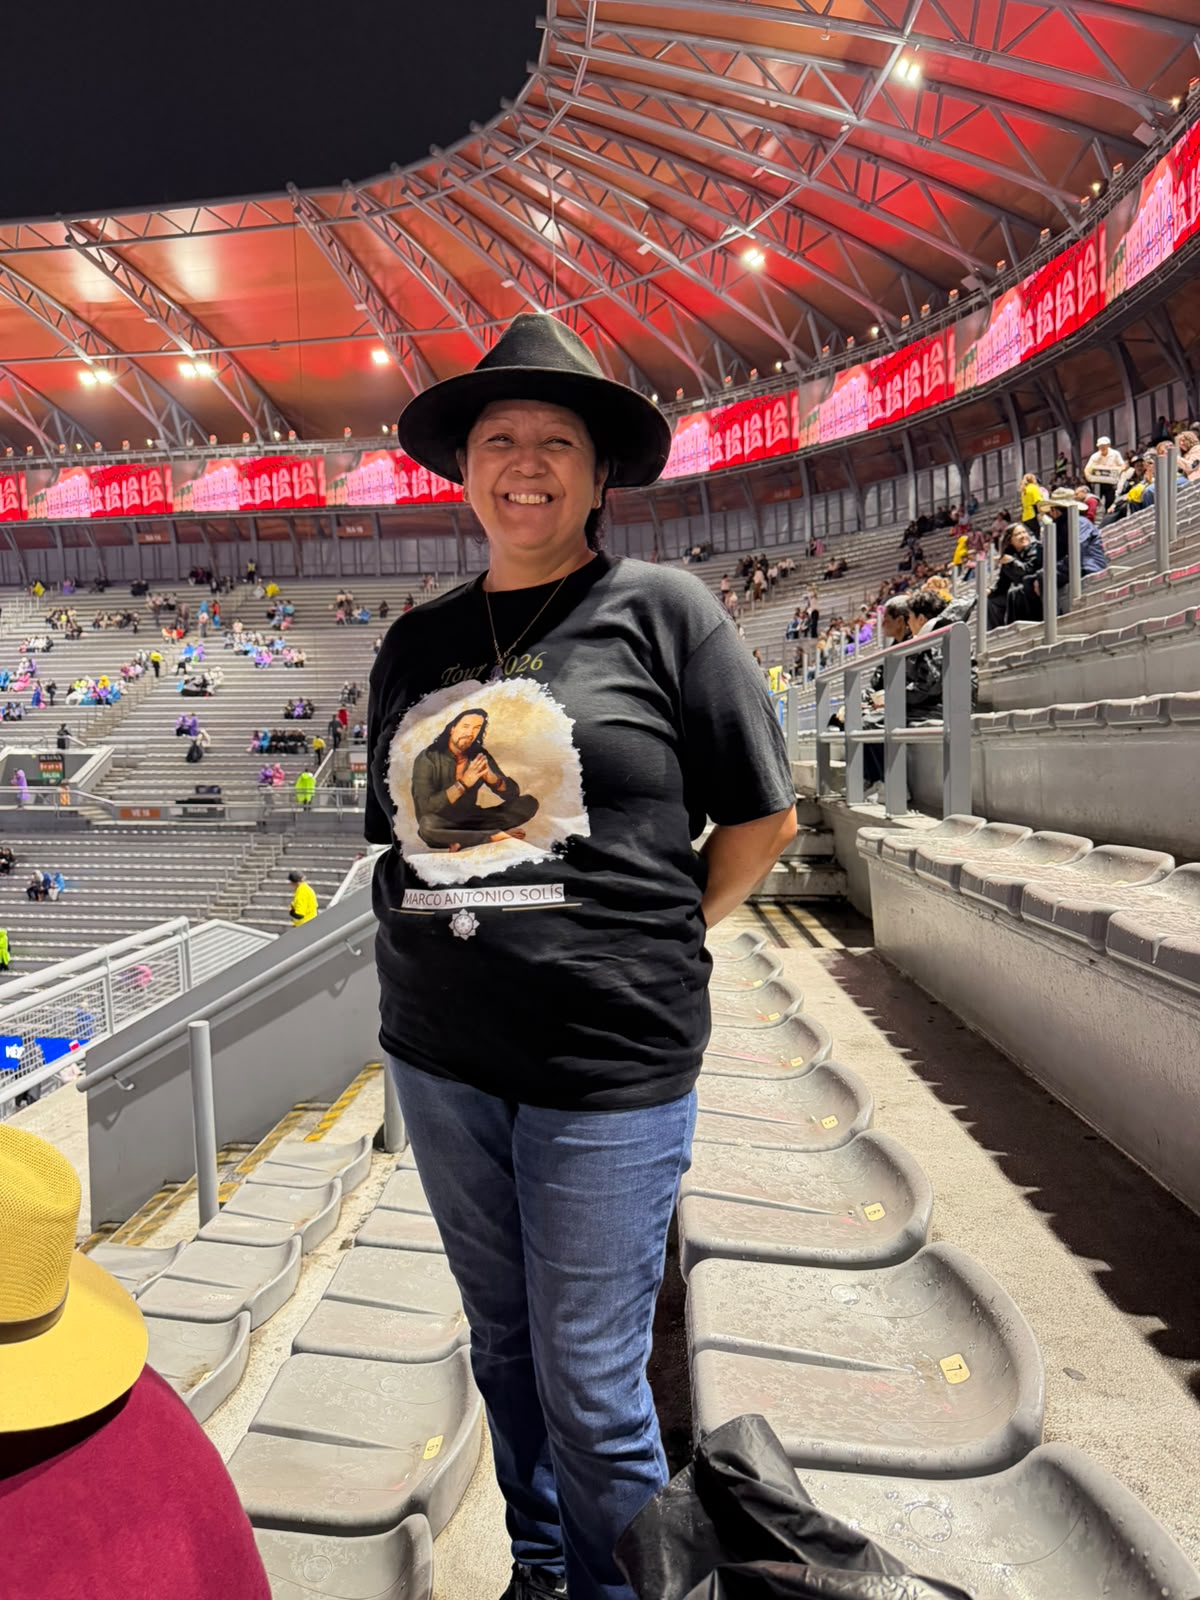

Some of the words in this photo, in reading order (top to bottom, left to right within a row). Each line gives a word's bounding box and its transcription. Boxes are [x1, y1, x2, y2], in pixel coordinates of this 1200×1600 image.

[441, 664, 487, 685] Tour
[501, 651, 547, 676] 026
[403, 893, 441, 906] MARCO
[445, 889, 515, 905] ANTONIO
